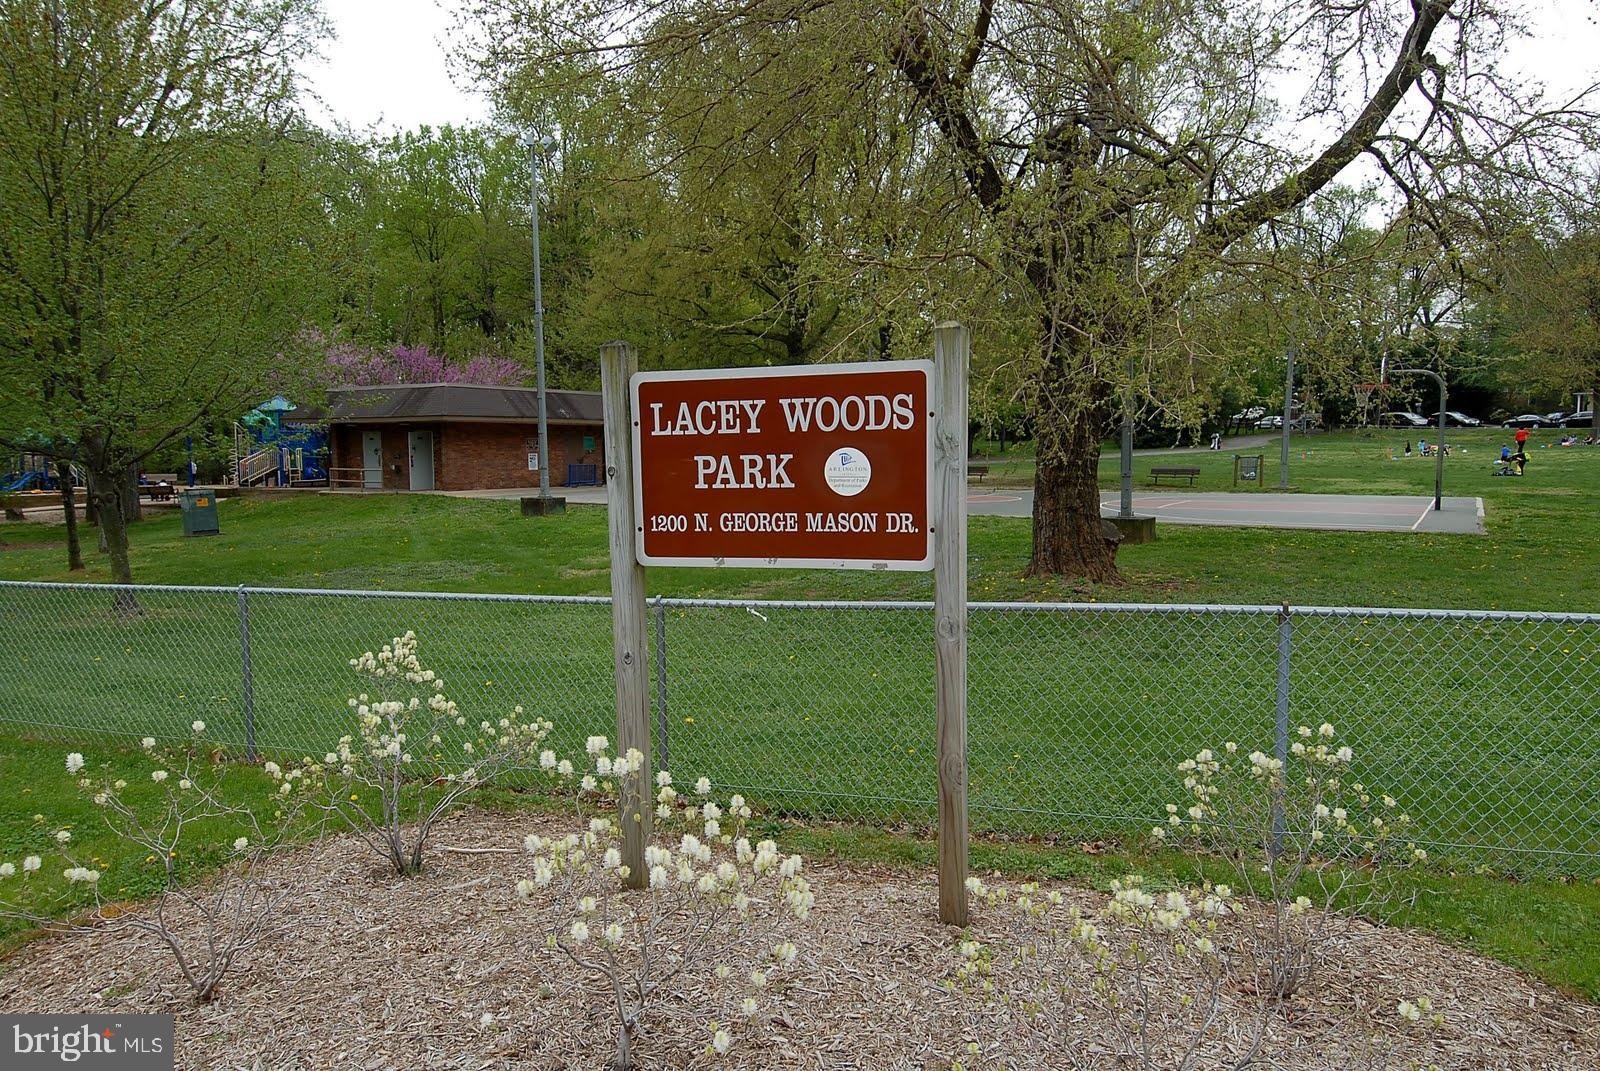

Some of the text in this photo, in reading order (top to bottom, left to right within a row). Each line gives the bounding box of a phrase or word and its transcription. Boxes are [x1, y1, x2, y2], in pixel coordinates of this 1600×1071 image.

[650, 393, 915, 437] LACEY WOODS
[693, 453, 795, 489] PARK
[650, 512, 919, 534] 1200 N. GEORGE MASON DR.
